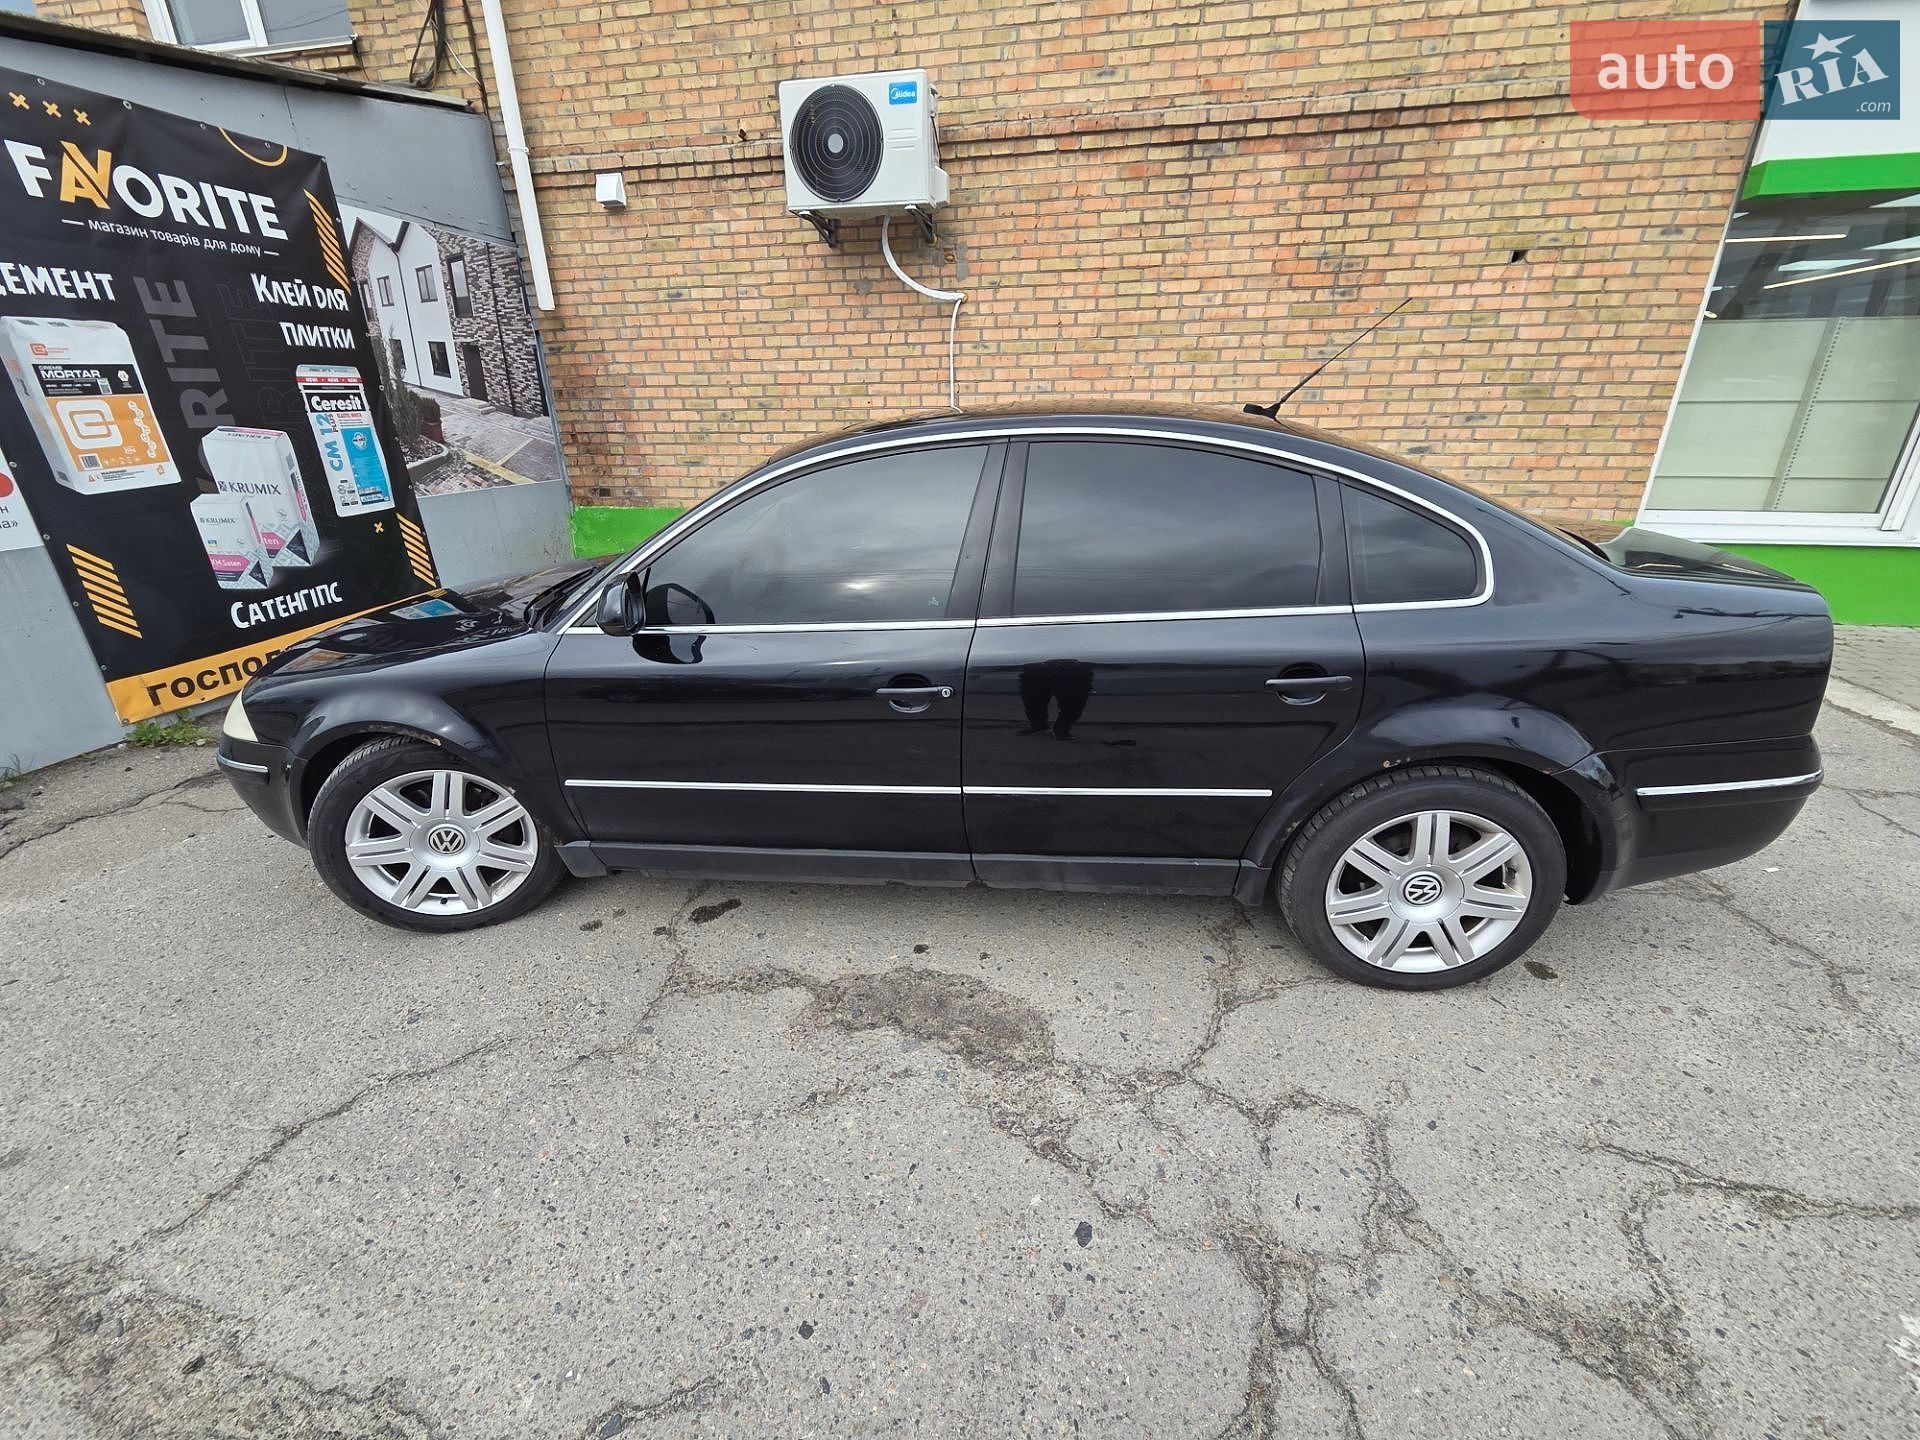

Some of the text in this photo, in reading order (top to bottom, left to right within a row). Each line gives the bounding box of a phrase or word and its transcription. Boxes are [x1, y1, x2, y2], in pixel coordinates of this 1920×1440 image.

[890, 87, 916, 100] Midea
[88, 218, 262, 258] магазин товарів для дому
[0, 261, 116, 302] ЕМЕНТ
[40, 369, 101, 379] MORTAR
[311, 394, 362, 412] Ceresit
[228, 481, 281, 496] KRUMIX
